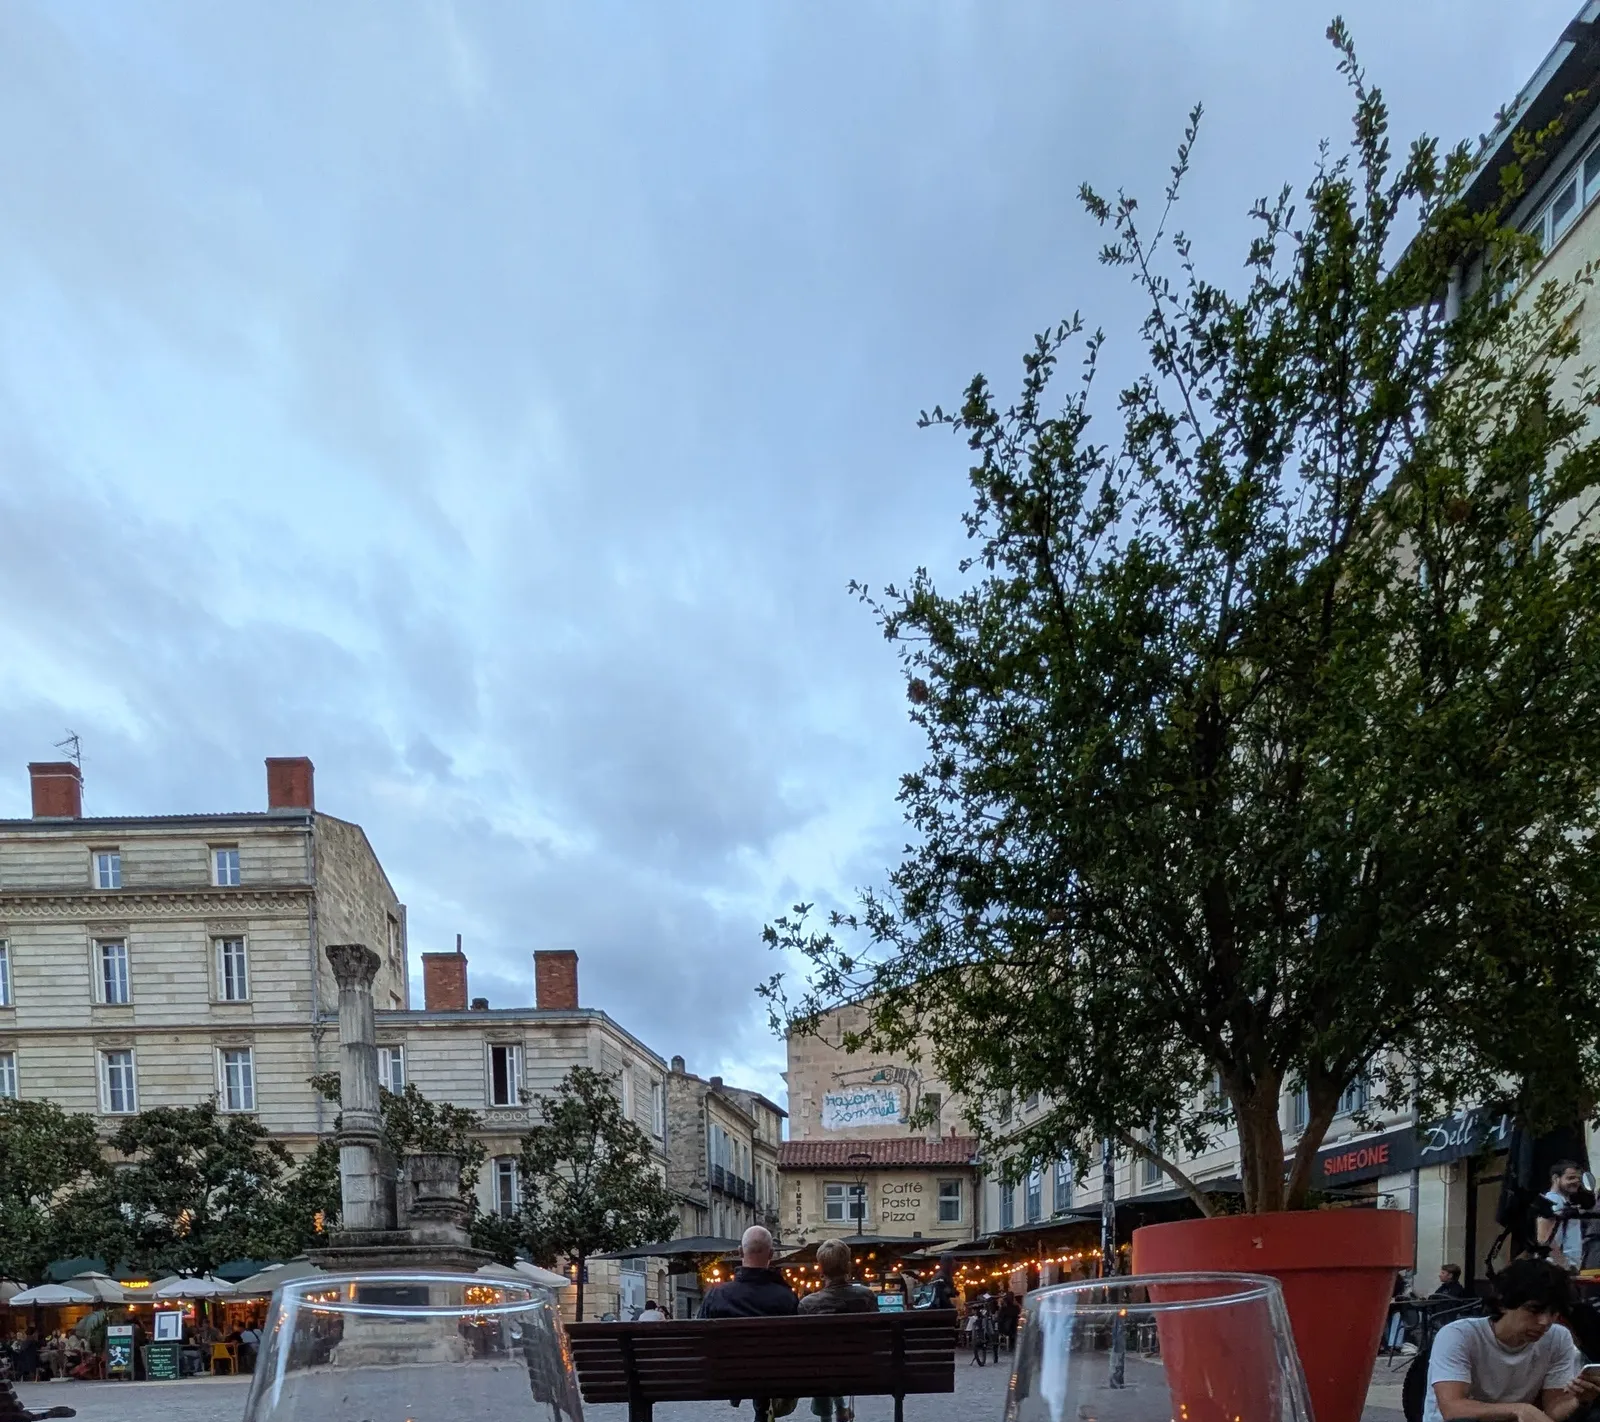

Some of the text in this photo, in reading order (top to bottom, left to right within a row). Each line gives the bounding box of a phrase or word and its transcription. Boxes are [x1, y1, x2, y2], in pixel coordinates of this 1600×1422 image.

[881, 1089, 897, 1102] de
[1323, 1143, 1390, 1176] SIMEONE
[882, 1182, 923, 1195] Caffé
[882, 1197, 921, 1208] Pasta
[882, 1211, 915, 1222] Pizza
